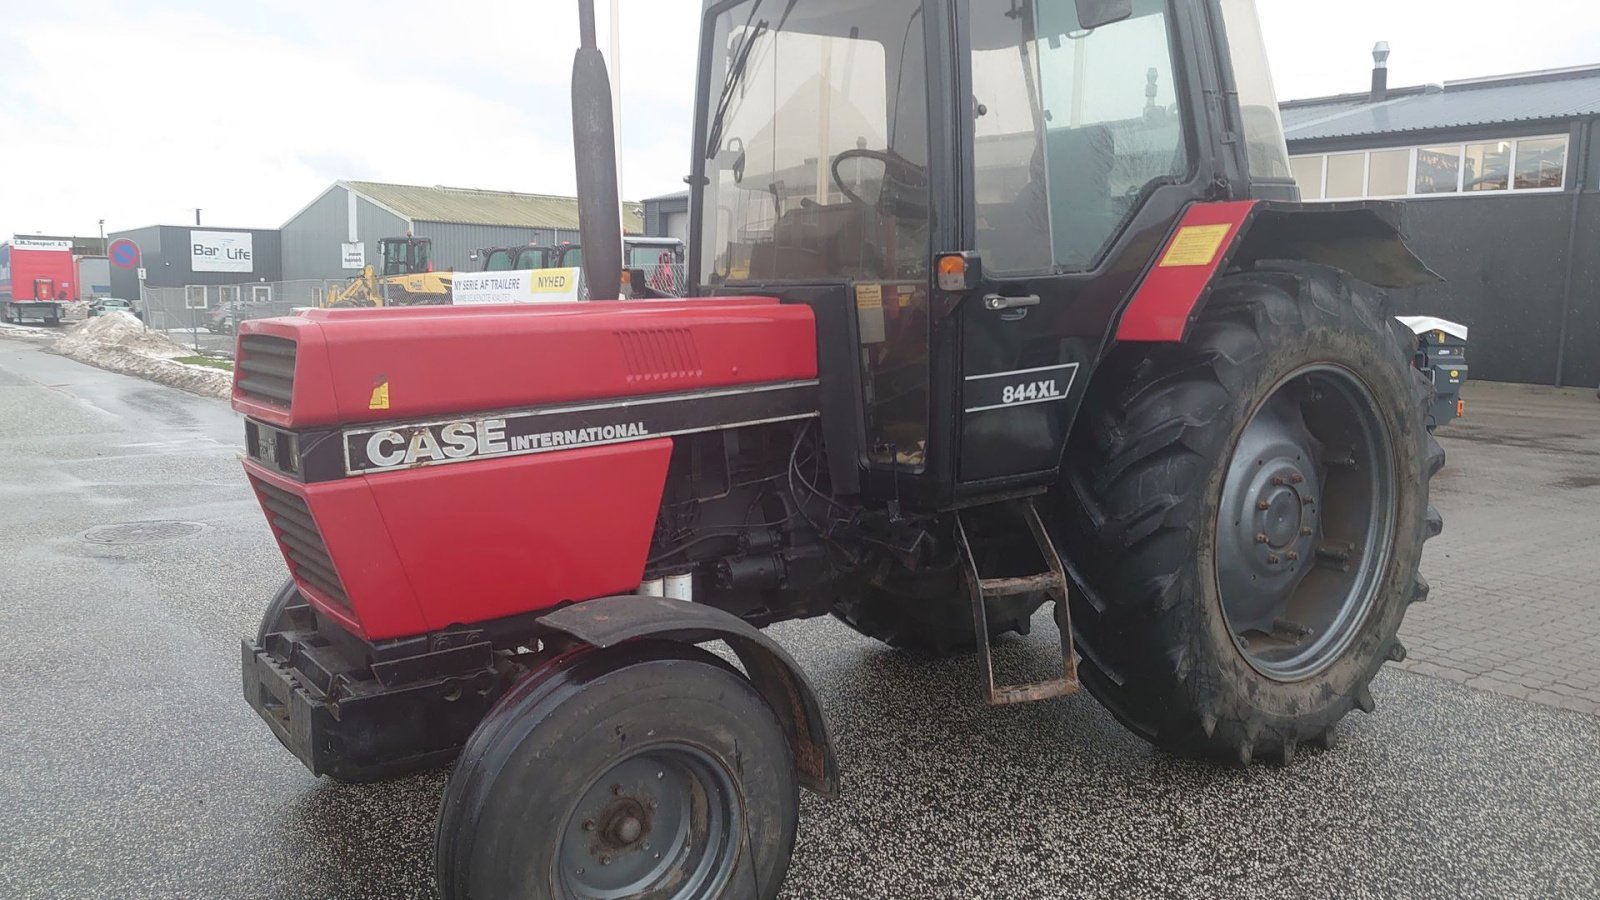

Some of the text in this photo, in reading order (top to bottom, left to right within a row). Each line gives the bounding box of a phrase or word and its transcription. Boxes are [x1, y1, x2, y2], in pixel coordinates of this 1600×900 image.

[193, 244, 251, 260] Bar Life
[454, 278, 520, 290] NY SERIE AF TRAILERE
[538, 276, 565, 288] NYHED
[1002, 380, 1060, 403] 844XL
[366, 419, 648, 466] CASE INTERNATIONAL
